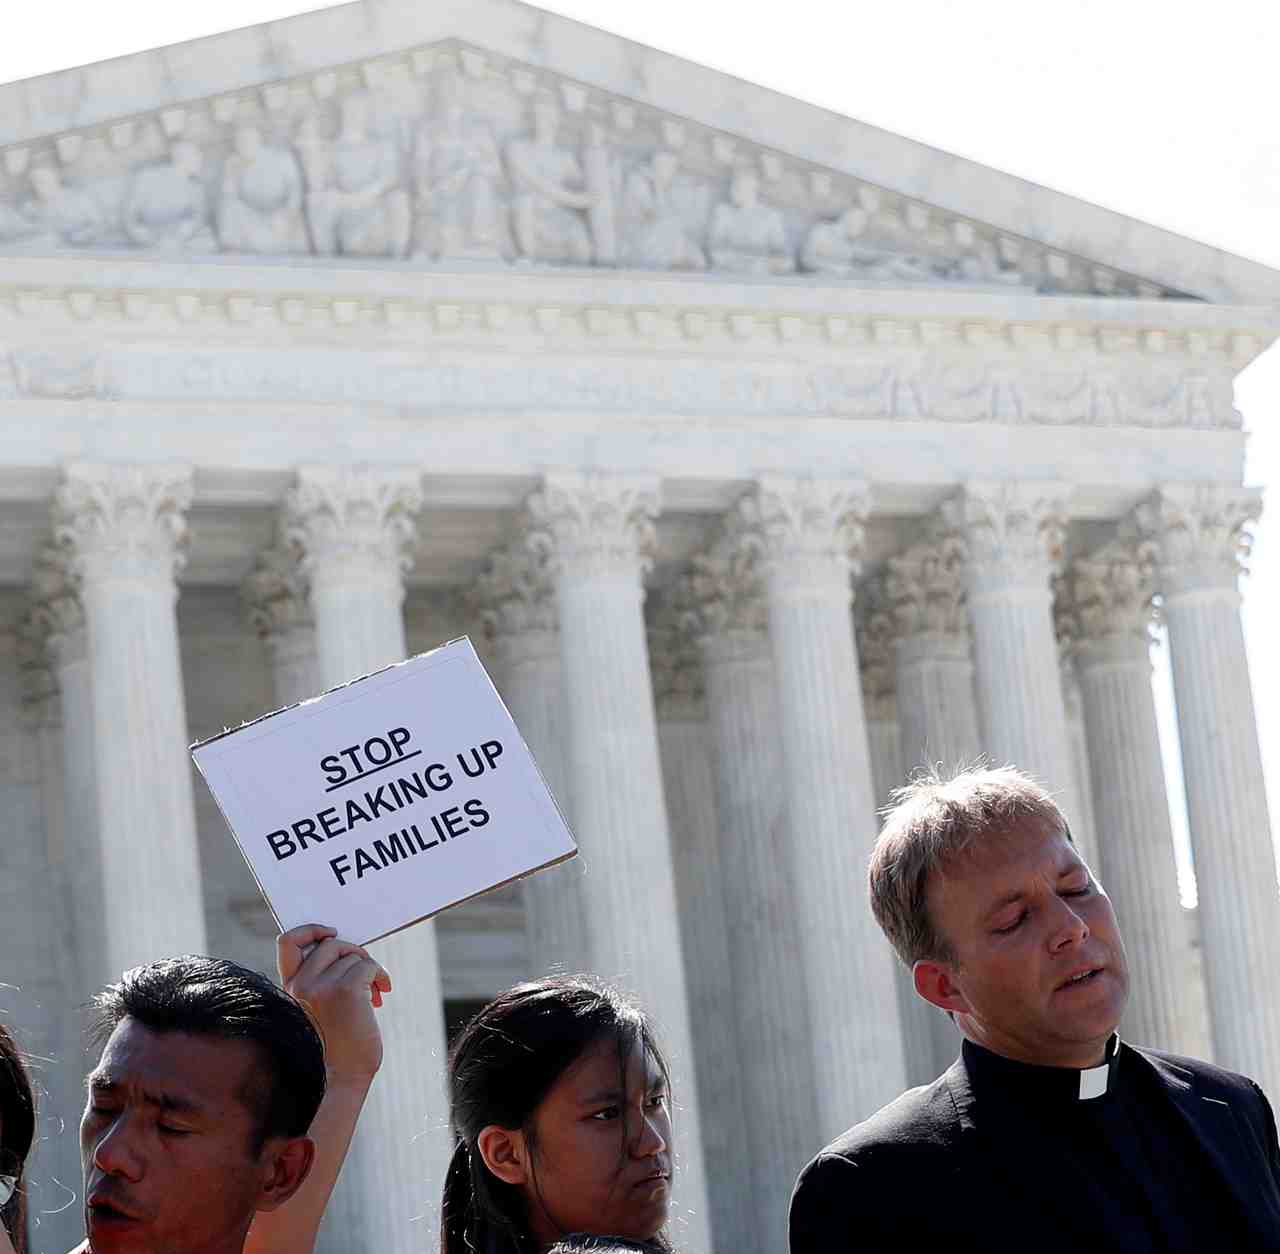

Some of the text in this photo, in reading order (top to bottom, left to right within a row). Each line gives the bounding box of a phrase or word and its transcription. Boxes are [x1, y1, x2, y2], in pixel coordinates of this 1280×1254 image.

[321, 728, 412, 785] STOP
[266, 741, 503, 860] BREAKING UP
[330, 800, 490, 886] FAMILIES
